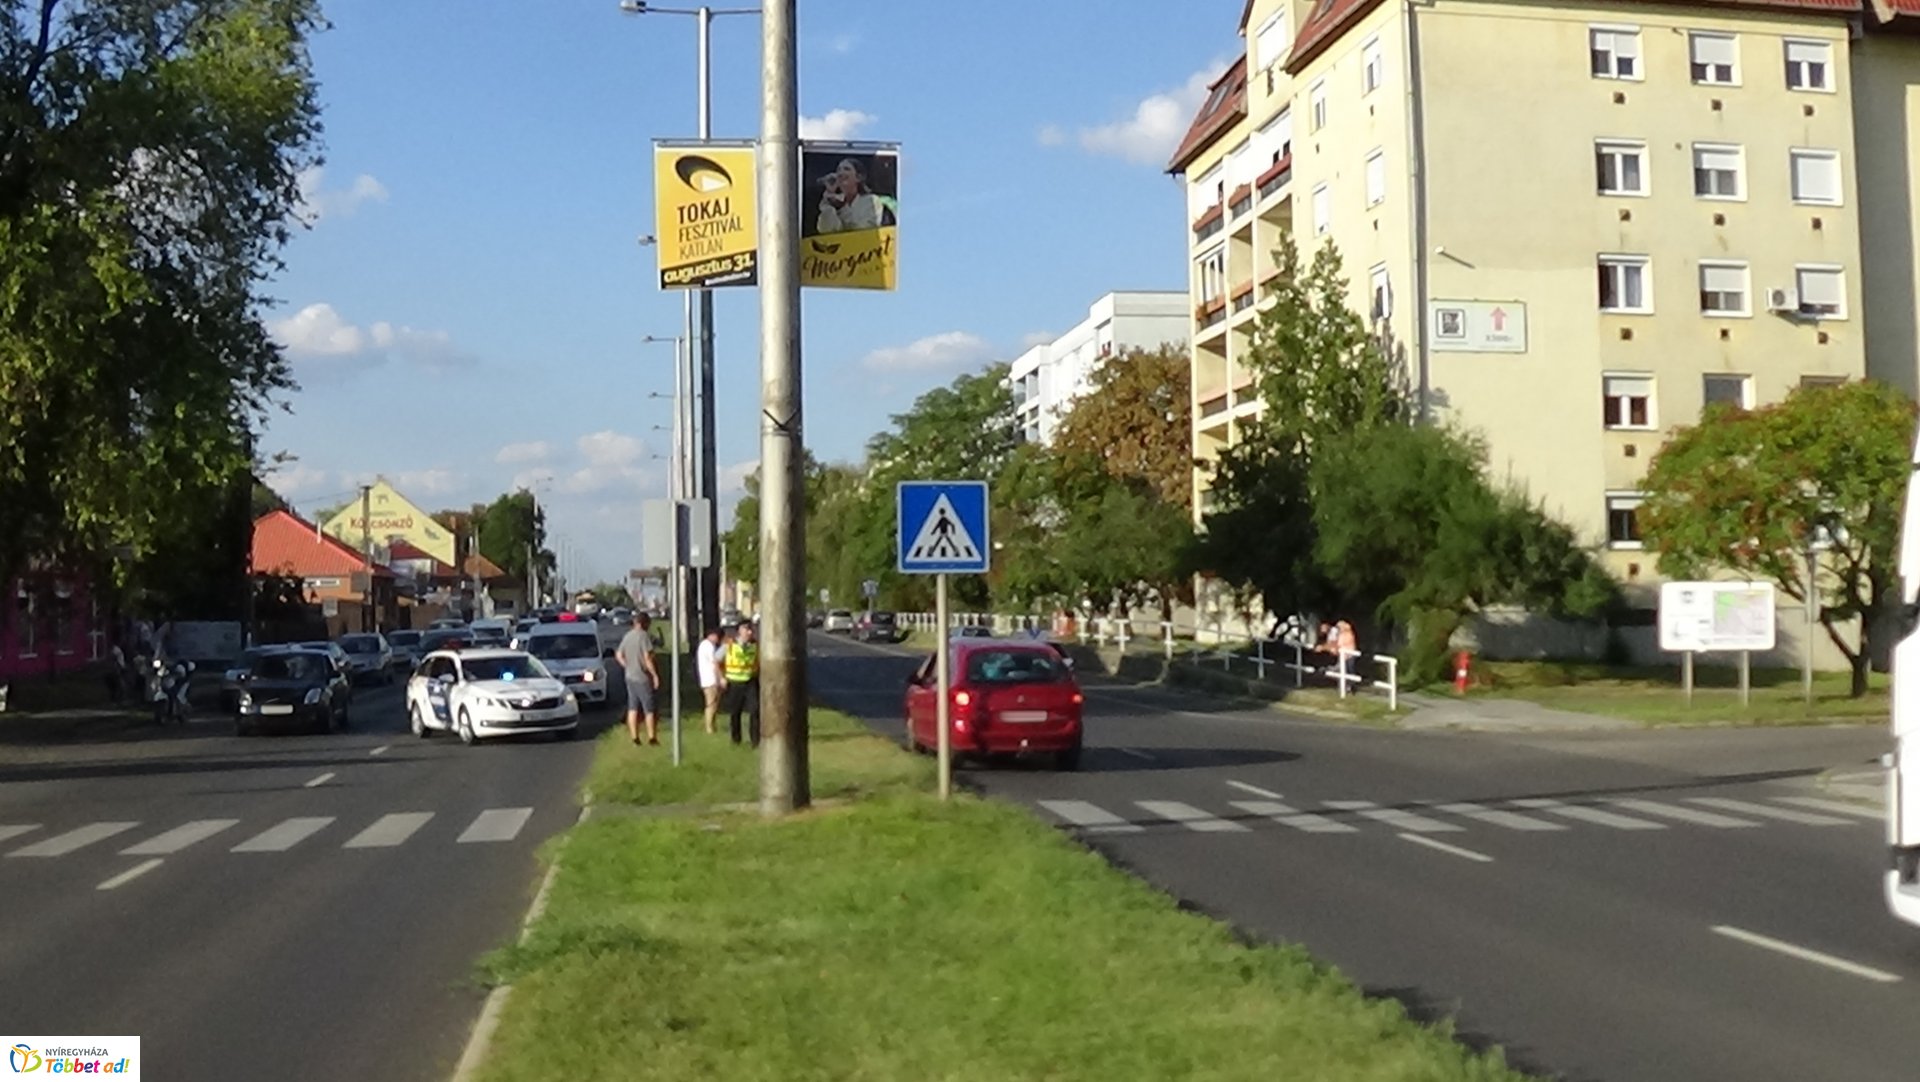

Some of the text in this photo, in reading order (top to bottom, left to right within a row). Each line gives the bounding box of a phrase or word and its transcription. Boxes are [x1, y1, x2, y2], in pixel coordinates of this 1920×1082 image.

[677, 197, 730, 225] TOKAJ
[678, 214, 744, 243] FESZTIVÁL
[679, 238, 724, 261] KATLAN
[663, 259, 733, 284] augusztus
